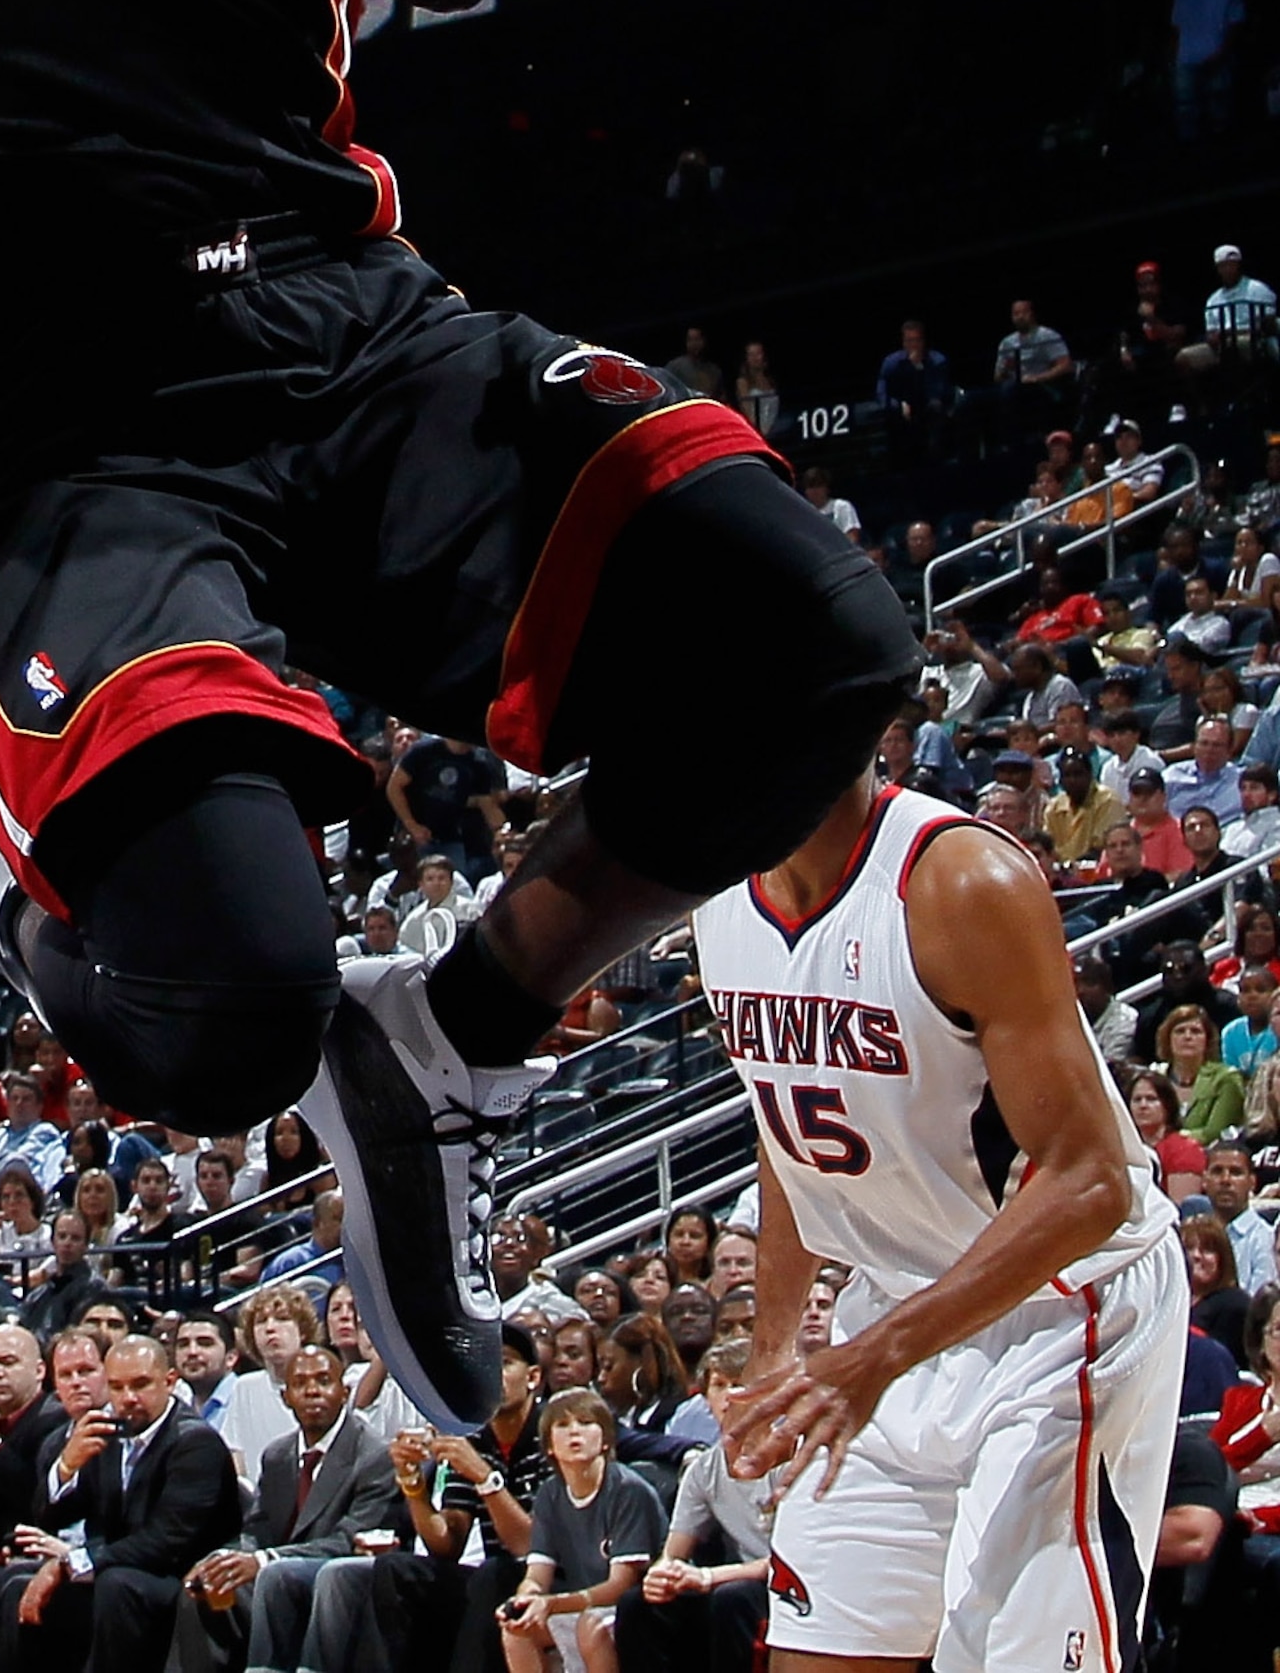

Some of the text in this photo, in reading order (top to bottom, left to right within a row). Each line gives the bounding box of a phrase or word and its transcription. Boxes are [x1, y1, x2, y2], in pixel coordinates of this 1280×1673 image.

[797, 404, 850, 439] 102
[710, 990, 910, 1076] HAWKS
[754, 1080, 872, 1176] 15
